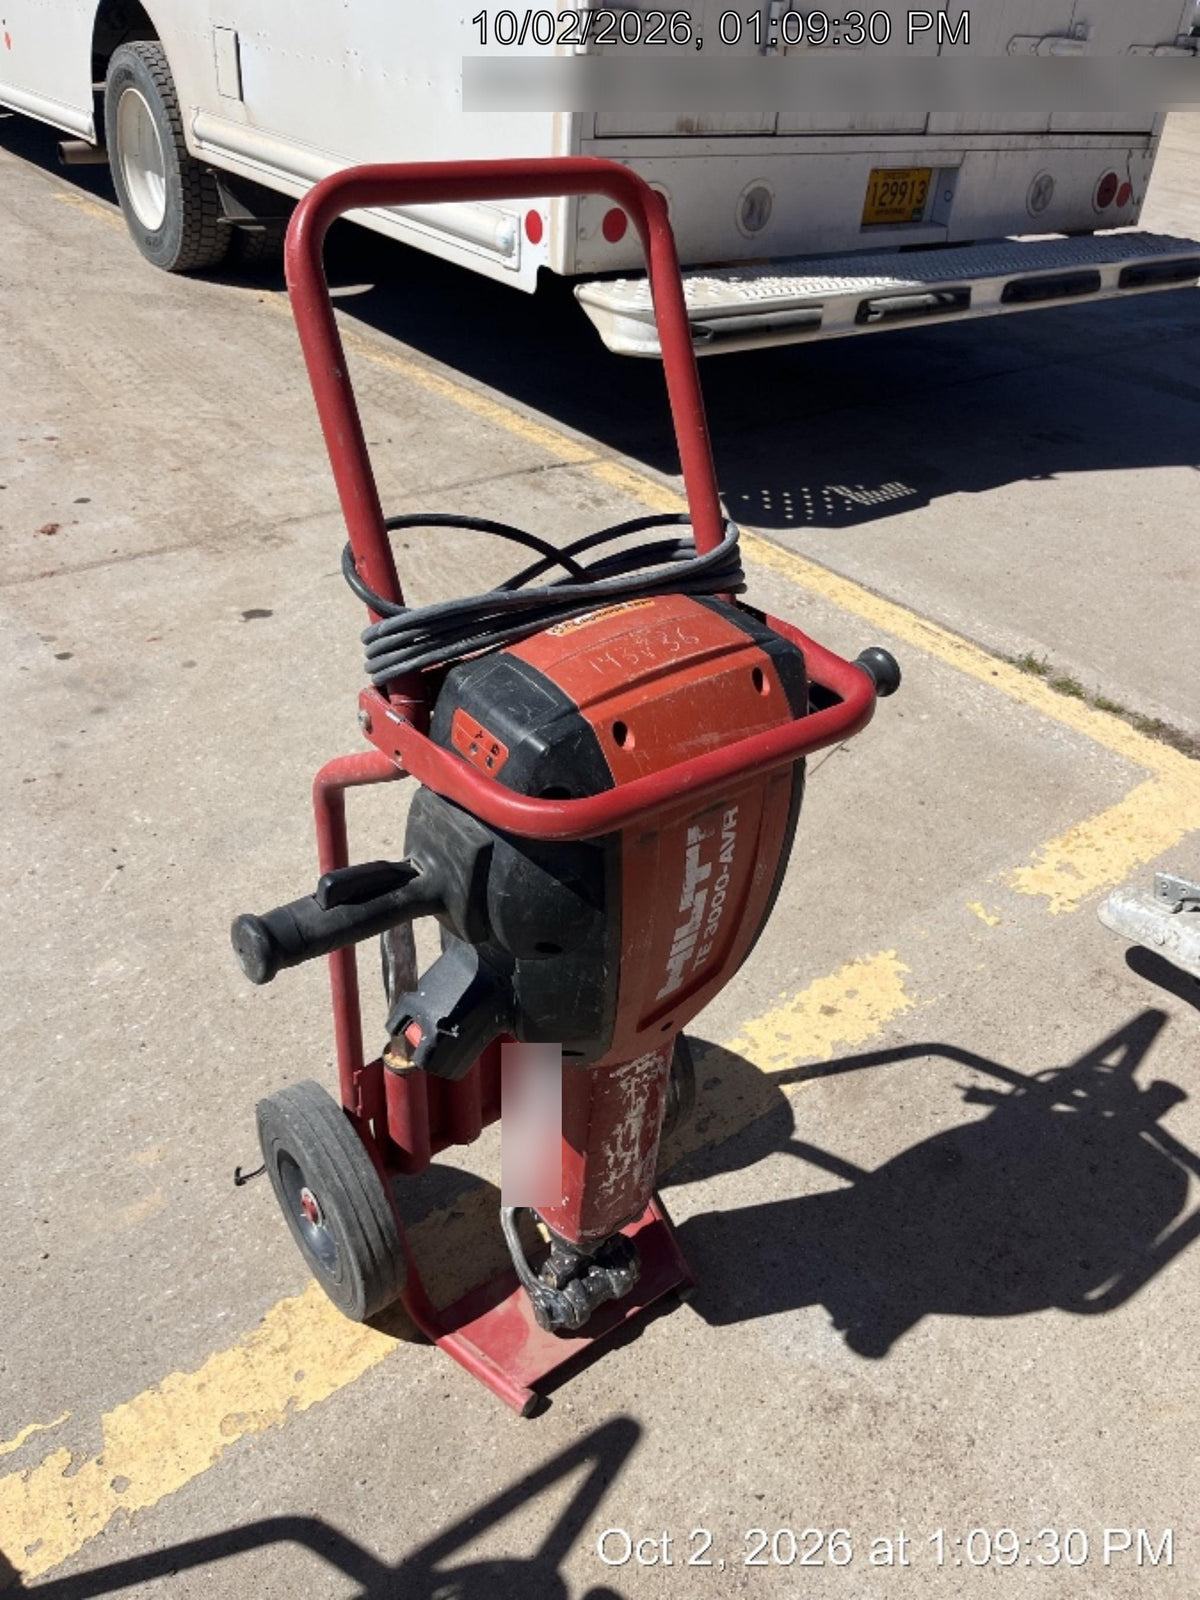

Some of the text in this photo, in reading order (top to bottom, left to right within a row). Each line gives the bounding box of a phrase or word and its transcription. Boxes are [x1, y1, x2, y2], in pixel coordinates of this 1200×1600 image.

[872, 181, 927, 207] 129913
[692, 806, 739, 971] TE 3000-AVR
